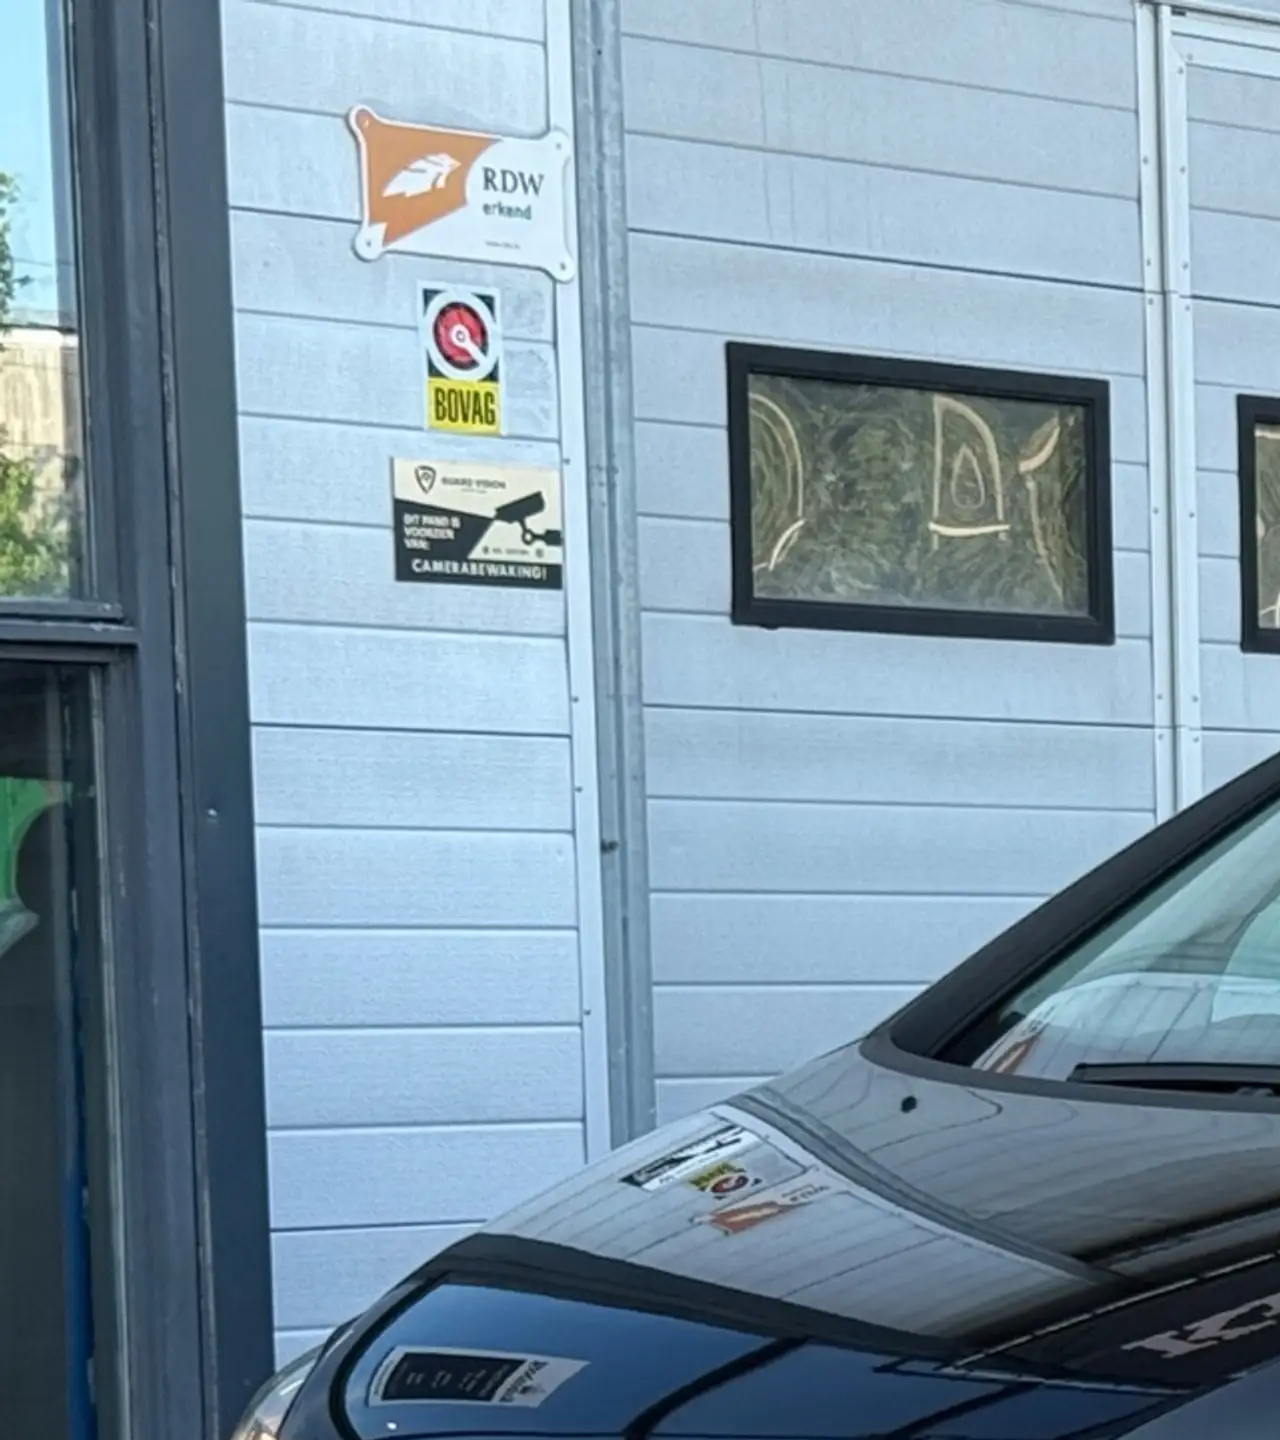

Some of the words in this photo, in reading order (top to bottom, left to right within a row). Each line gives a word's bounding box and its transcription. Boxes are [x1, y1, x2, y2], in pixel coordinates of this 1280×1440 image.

[482, 167, 544, 196] RDW
[483, 202, 532, 220] erkend
[434, 387, 496, 426] BOVAG
[411, 558, 548, 581] CAMERABEWAKING!
